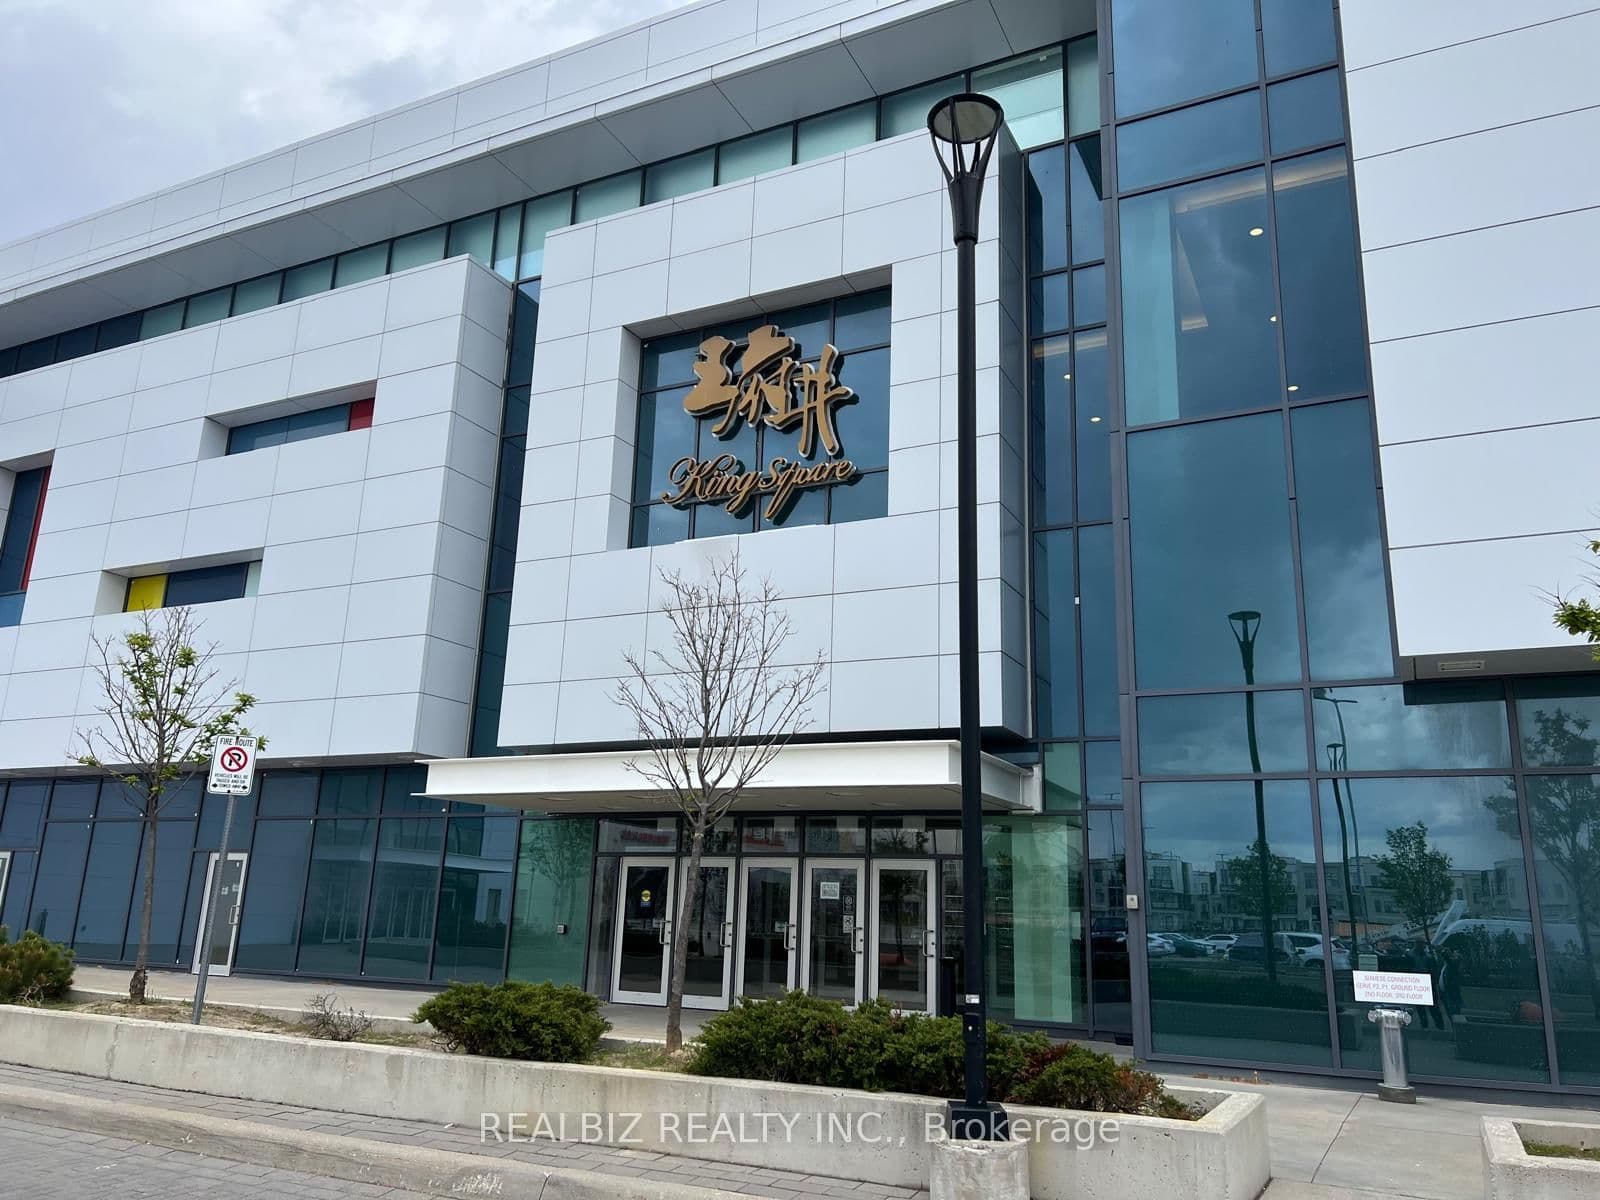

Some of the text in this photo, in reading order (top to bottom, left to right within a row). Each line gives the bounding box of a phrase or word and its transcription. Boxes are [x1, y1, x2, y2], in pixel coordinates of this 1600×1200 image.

[661, 454, 857, 521] King Square
[220, 737, 233, 746] FIRE
